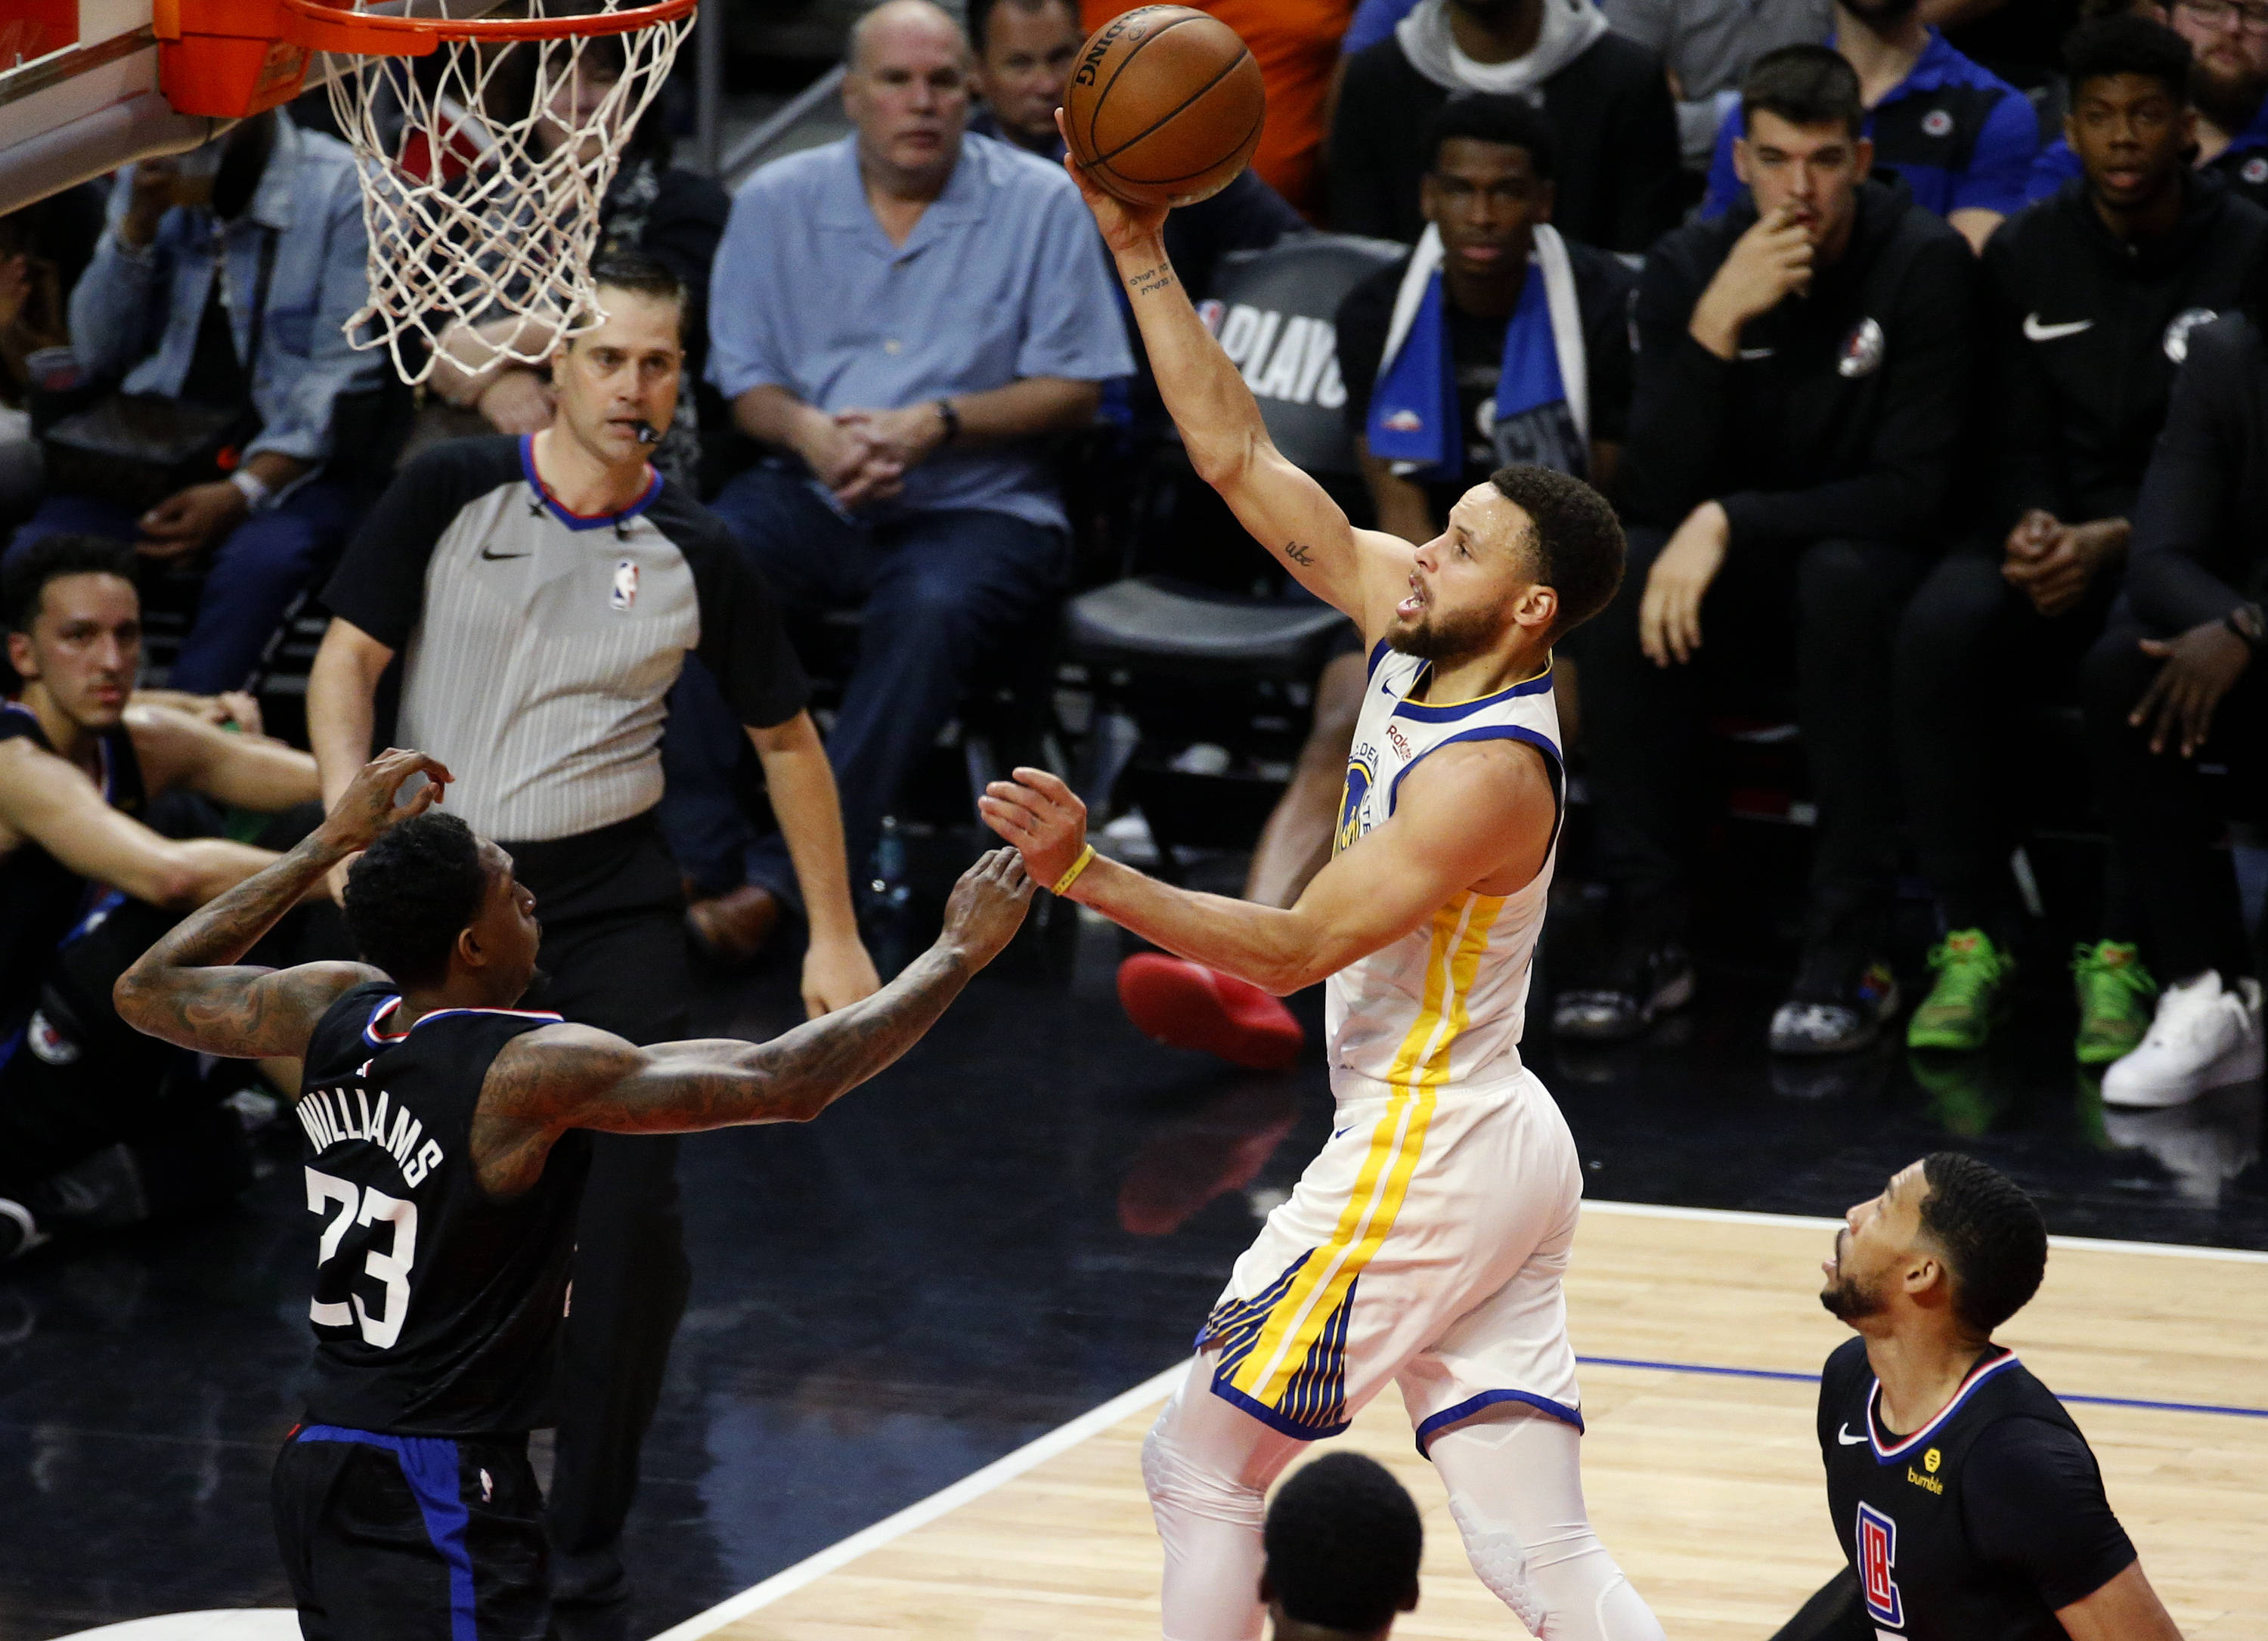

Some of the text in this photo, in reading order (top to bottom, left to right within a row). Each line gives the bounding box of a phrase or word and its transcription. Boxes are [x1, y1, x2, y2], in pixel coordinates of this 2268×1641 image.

[1076, 4, 1187, 87] PDING
[296, 1088, 444, 1188] WILLIAMS
[305, 1166, 417, 1349] 23
[1907, 1466, 1944, 1495] bumble
